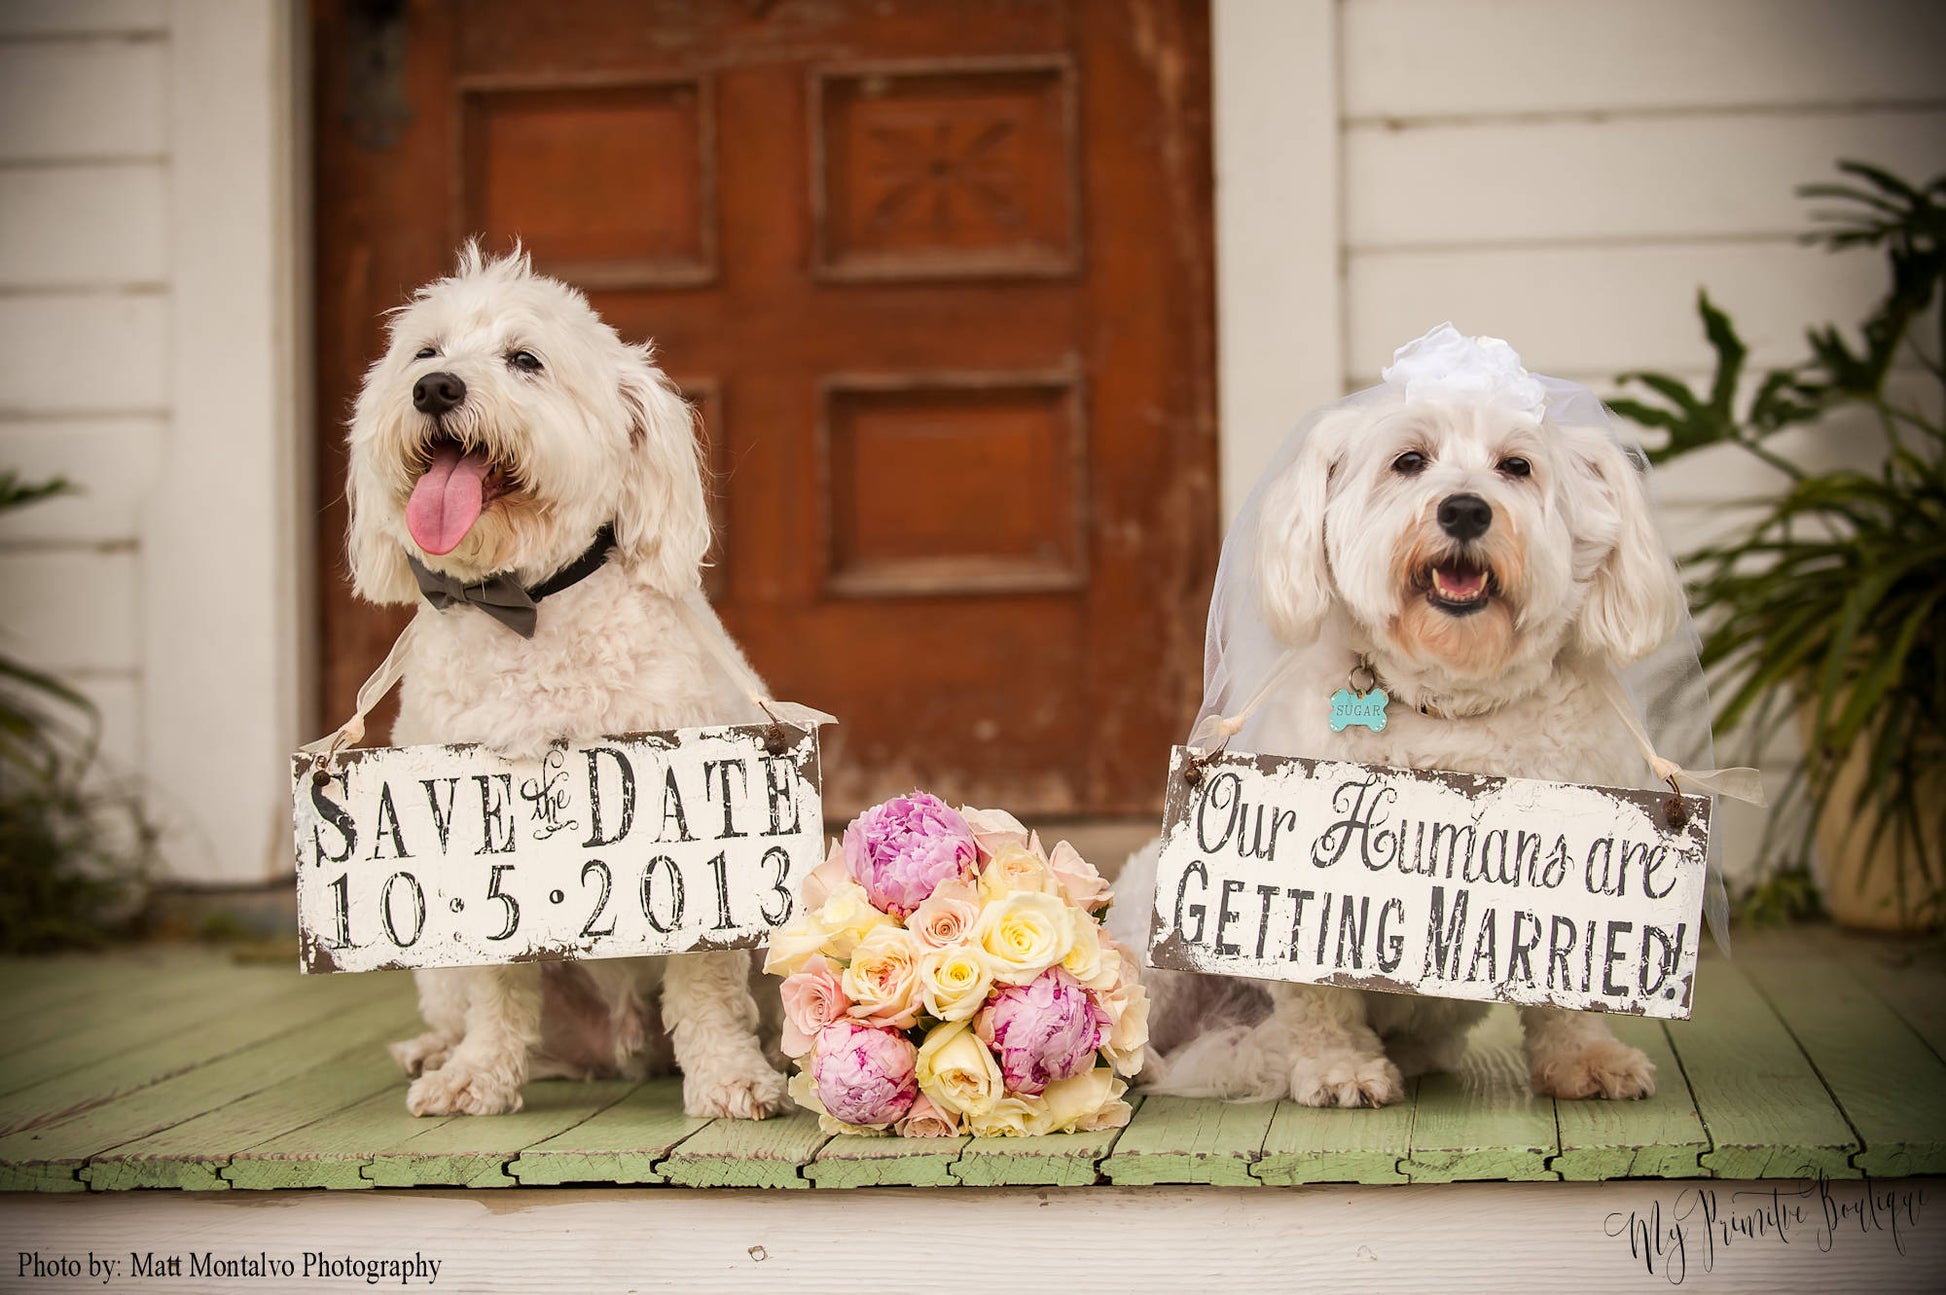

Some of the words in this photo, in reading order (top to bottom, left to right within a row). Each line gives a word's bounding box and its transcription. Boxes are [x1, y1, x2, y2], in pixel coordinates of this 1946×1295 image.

[1336, 704, 1381, 717] SUGAR
[311, 770, 516, 868] SAVE
[520, 750, 579, 840] the
[580, 747, 803, 849] DATE
[1196, 772, 1297, 863] Our
[1311, 773, 1575, 889] Humans
[1585, 836, 1677, 899] are
[1173, 860, 1406, 974] GETTING
[1423, 885, 1688, 1001] MARRIED!
